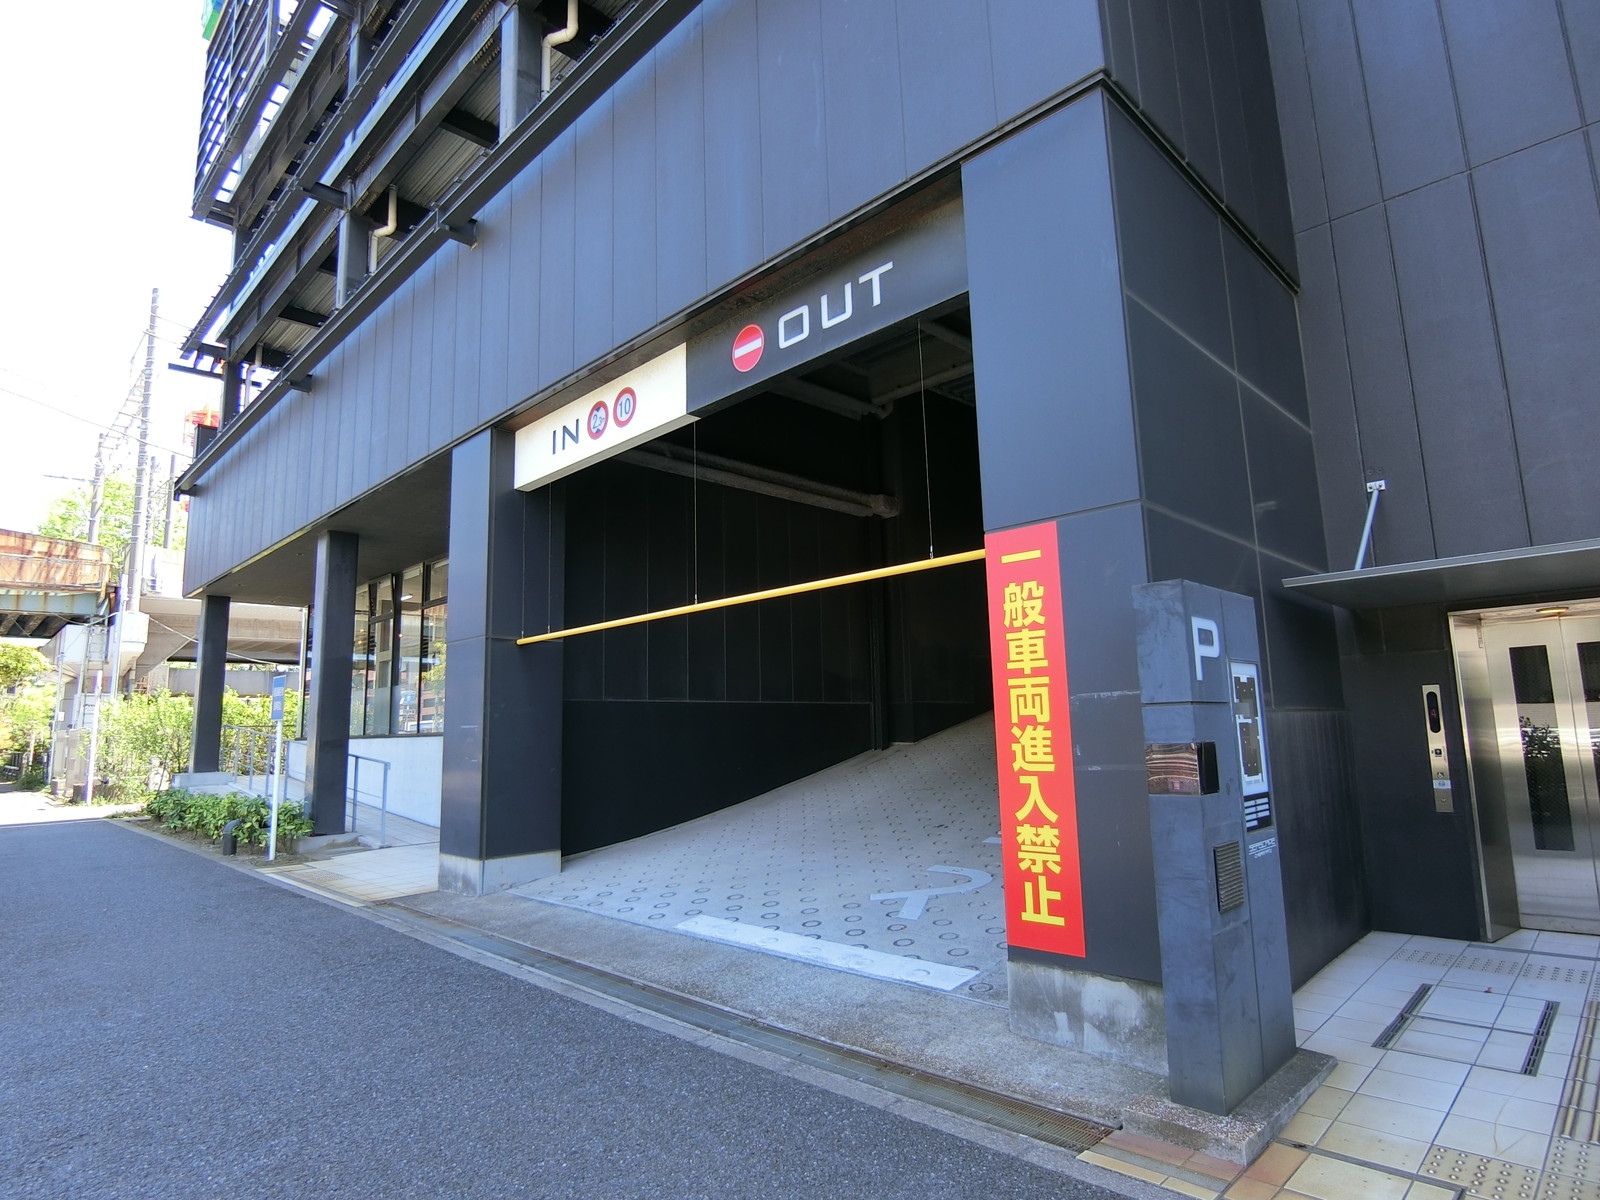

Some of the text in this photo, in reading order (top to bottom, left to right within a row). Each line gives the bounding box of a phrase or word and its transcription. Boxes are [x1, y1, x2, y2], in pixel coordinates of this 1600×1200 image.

[778, 261, 893, 349] OUT
[552, 418, 579, 455] IN
[619, 398, 631, 418] 10
[1191, 616, 1220, 681] P
[1000, 548, 1066, 928] 一般車両進入禁止
